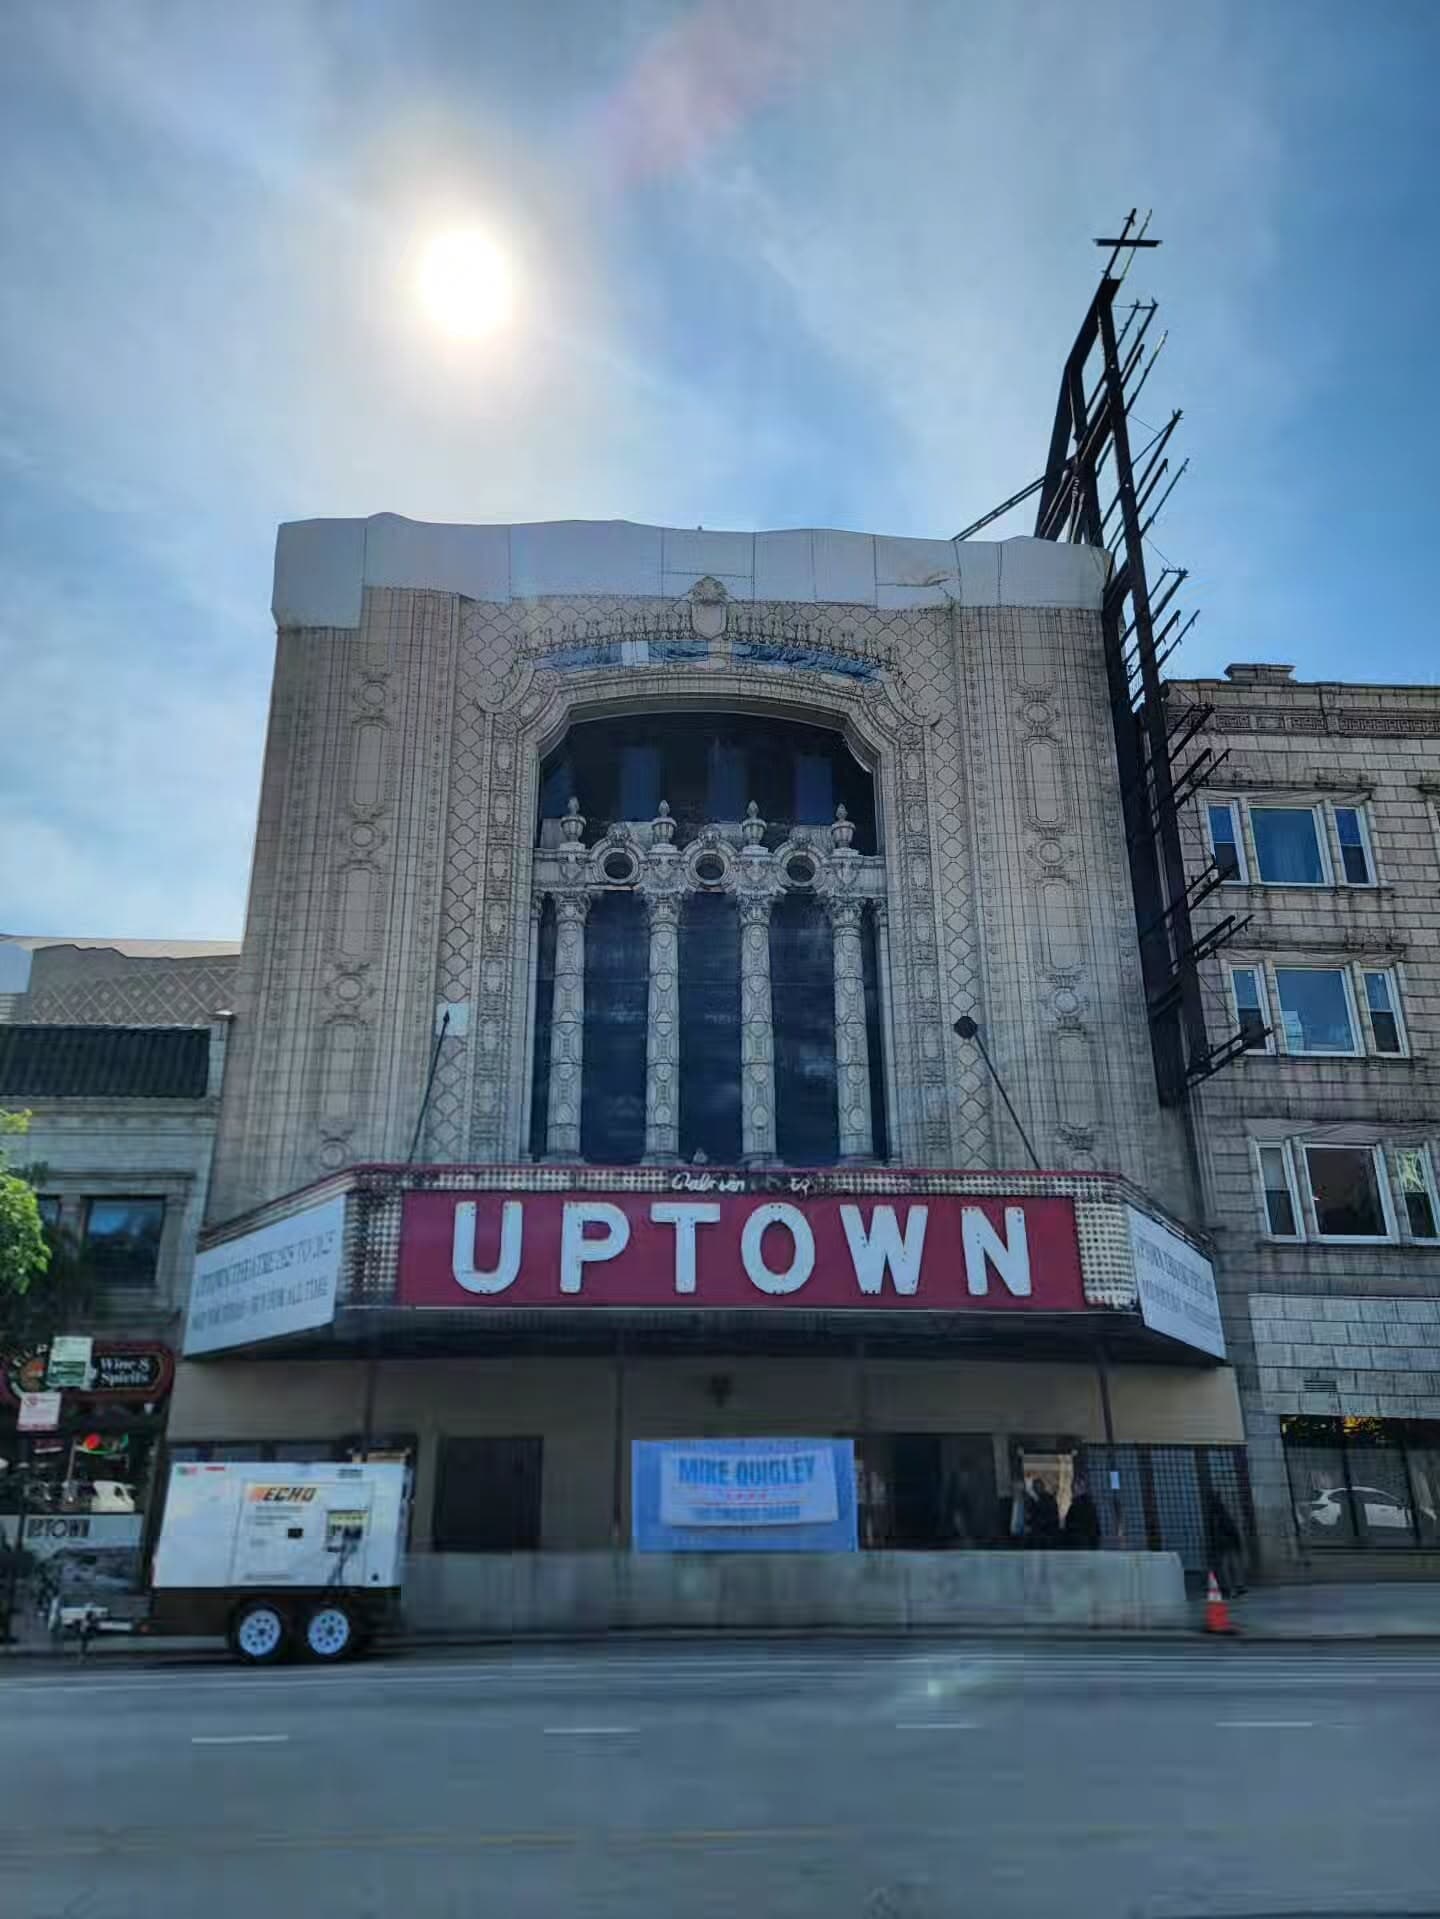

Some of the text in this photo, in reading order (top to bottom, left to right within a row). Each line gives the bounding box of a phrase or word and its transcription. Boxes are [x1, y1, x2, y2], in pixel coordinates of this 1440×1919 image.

[451, 1200, 1032, 1297] UPTOWN
[99, 1357, 134, 1370] Wine
[101, 1372, 149, 1386] Spirits
[679, 1455, 816, 1486] MIKE QUIGLEY
